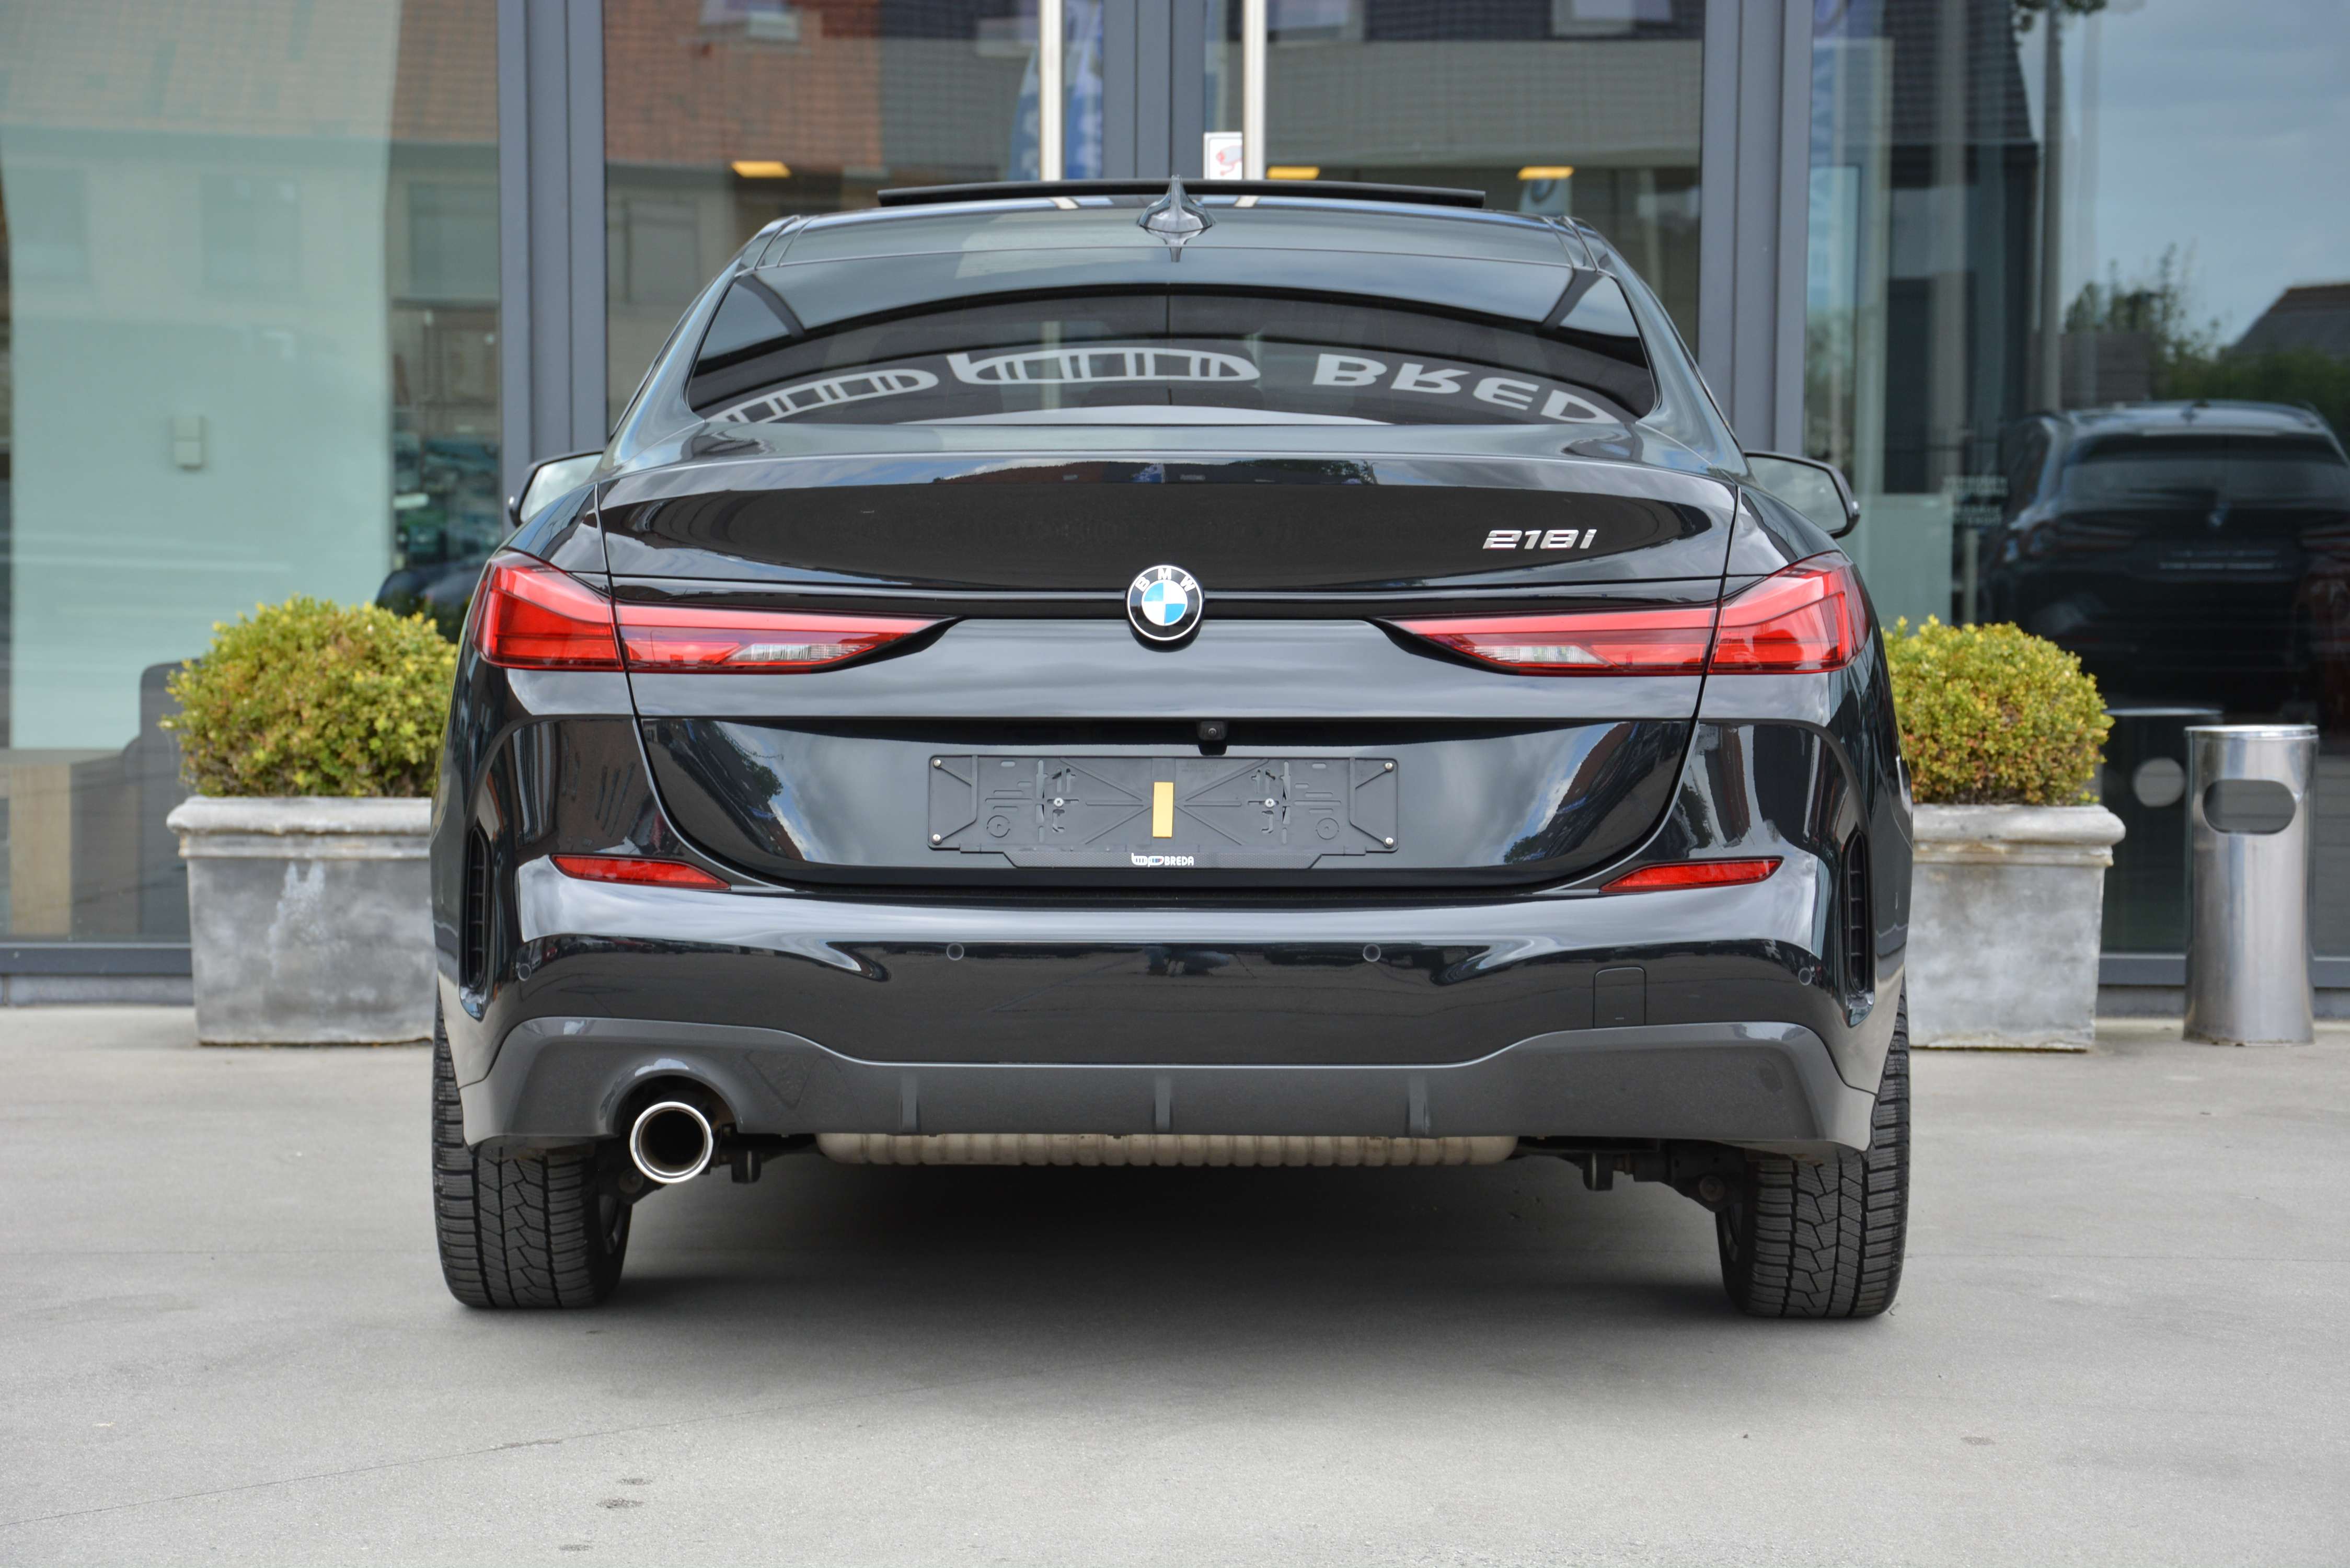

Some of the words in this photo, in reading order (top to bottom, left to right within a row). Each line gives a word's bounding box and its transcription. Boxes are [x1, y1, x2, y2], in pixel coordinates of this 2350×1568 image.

[1482, 529, 1597, 549] 218i
[1134, 568, 1195, 592] BMW
[1164, 856, 1194, 866] BREDA
